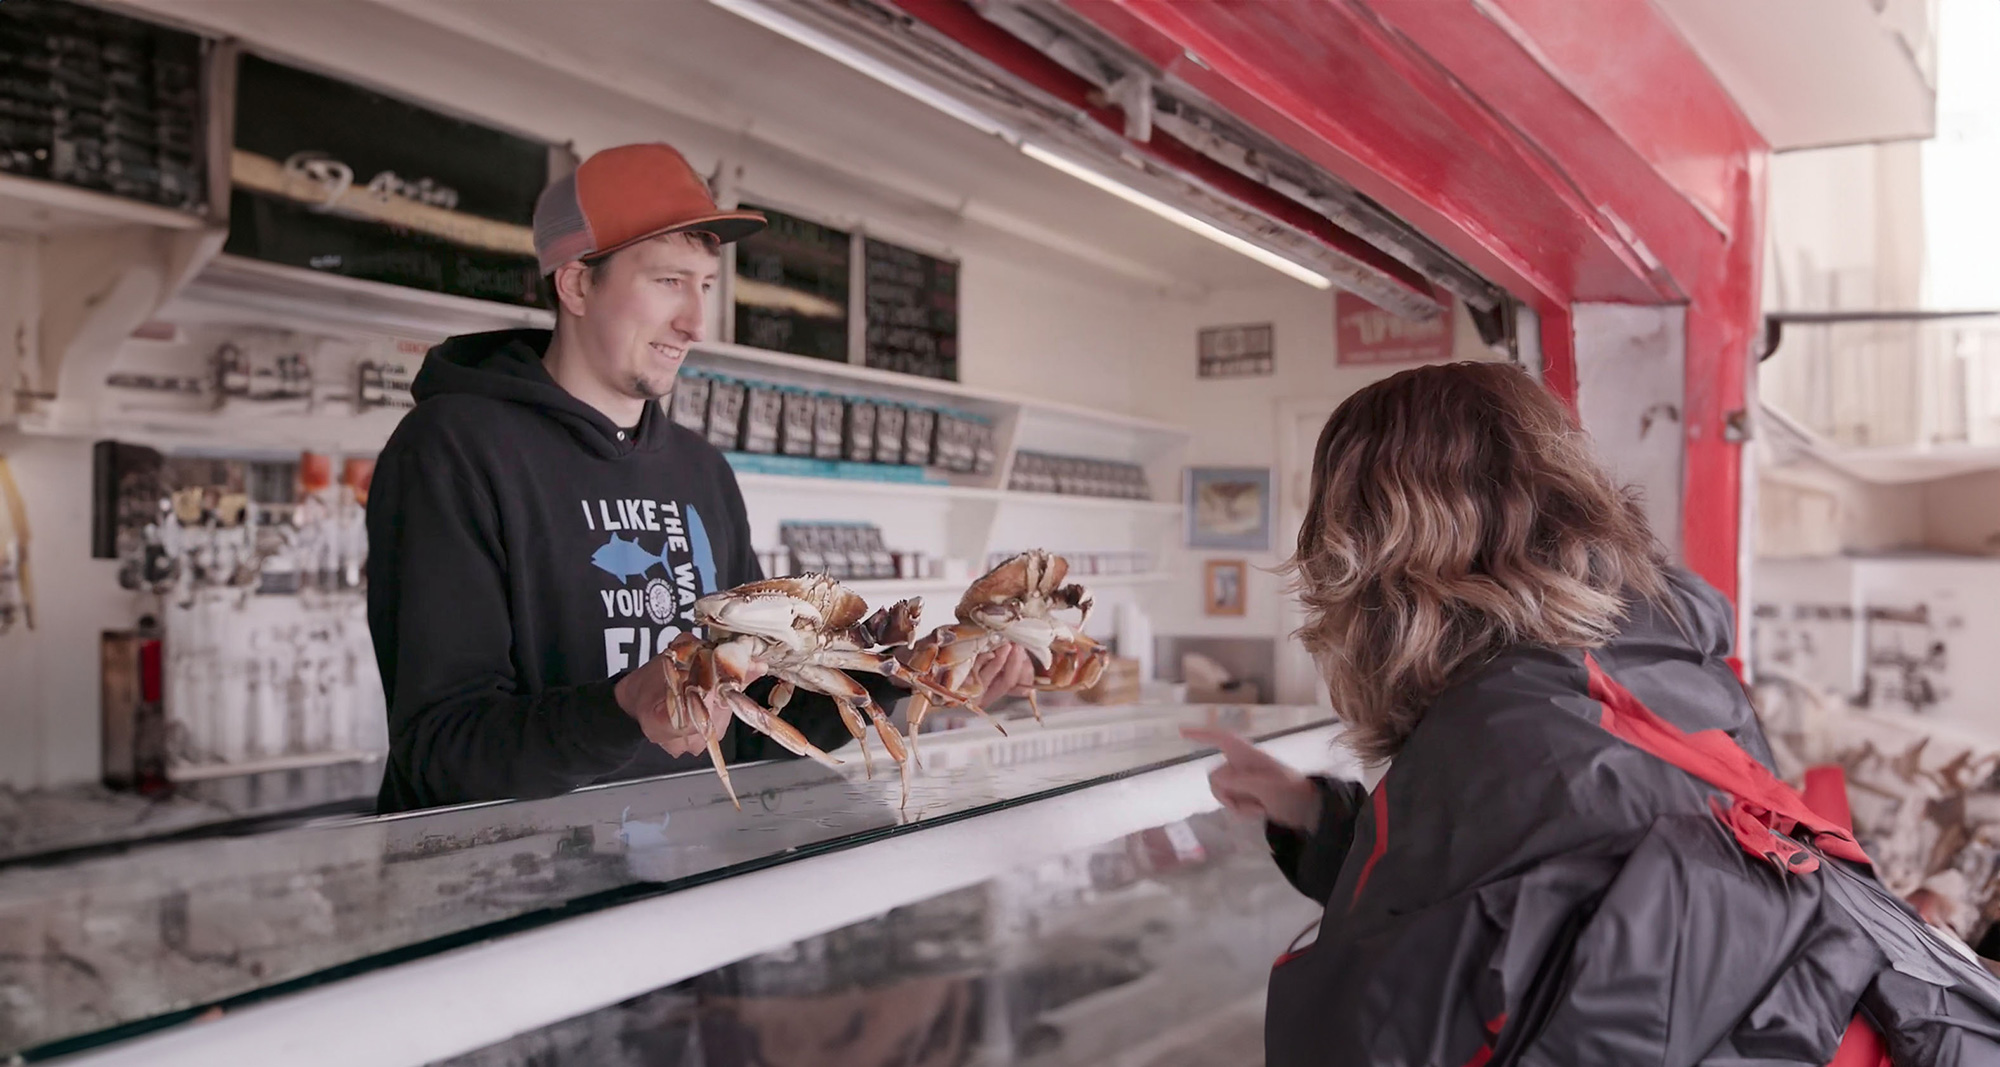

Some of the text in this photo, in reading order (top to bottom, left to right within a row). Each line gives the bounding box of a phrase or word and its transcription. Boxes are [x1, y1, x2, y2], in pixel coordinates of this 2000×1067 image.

[581, 500, 660, 531] I LIKE
[660, 501, 689, 553] THE
[600, 589, 644, 618] YOU
[673, 562, 697, 622] WAY
[604, 626, 702, 678] FI
